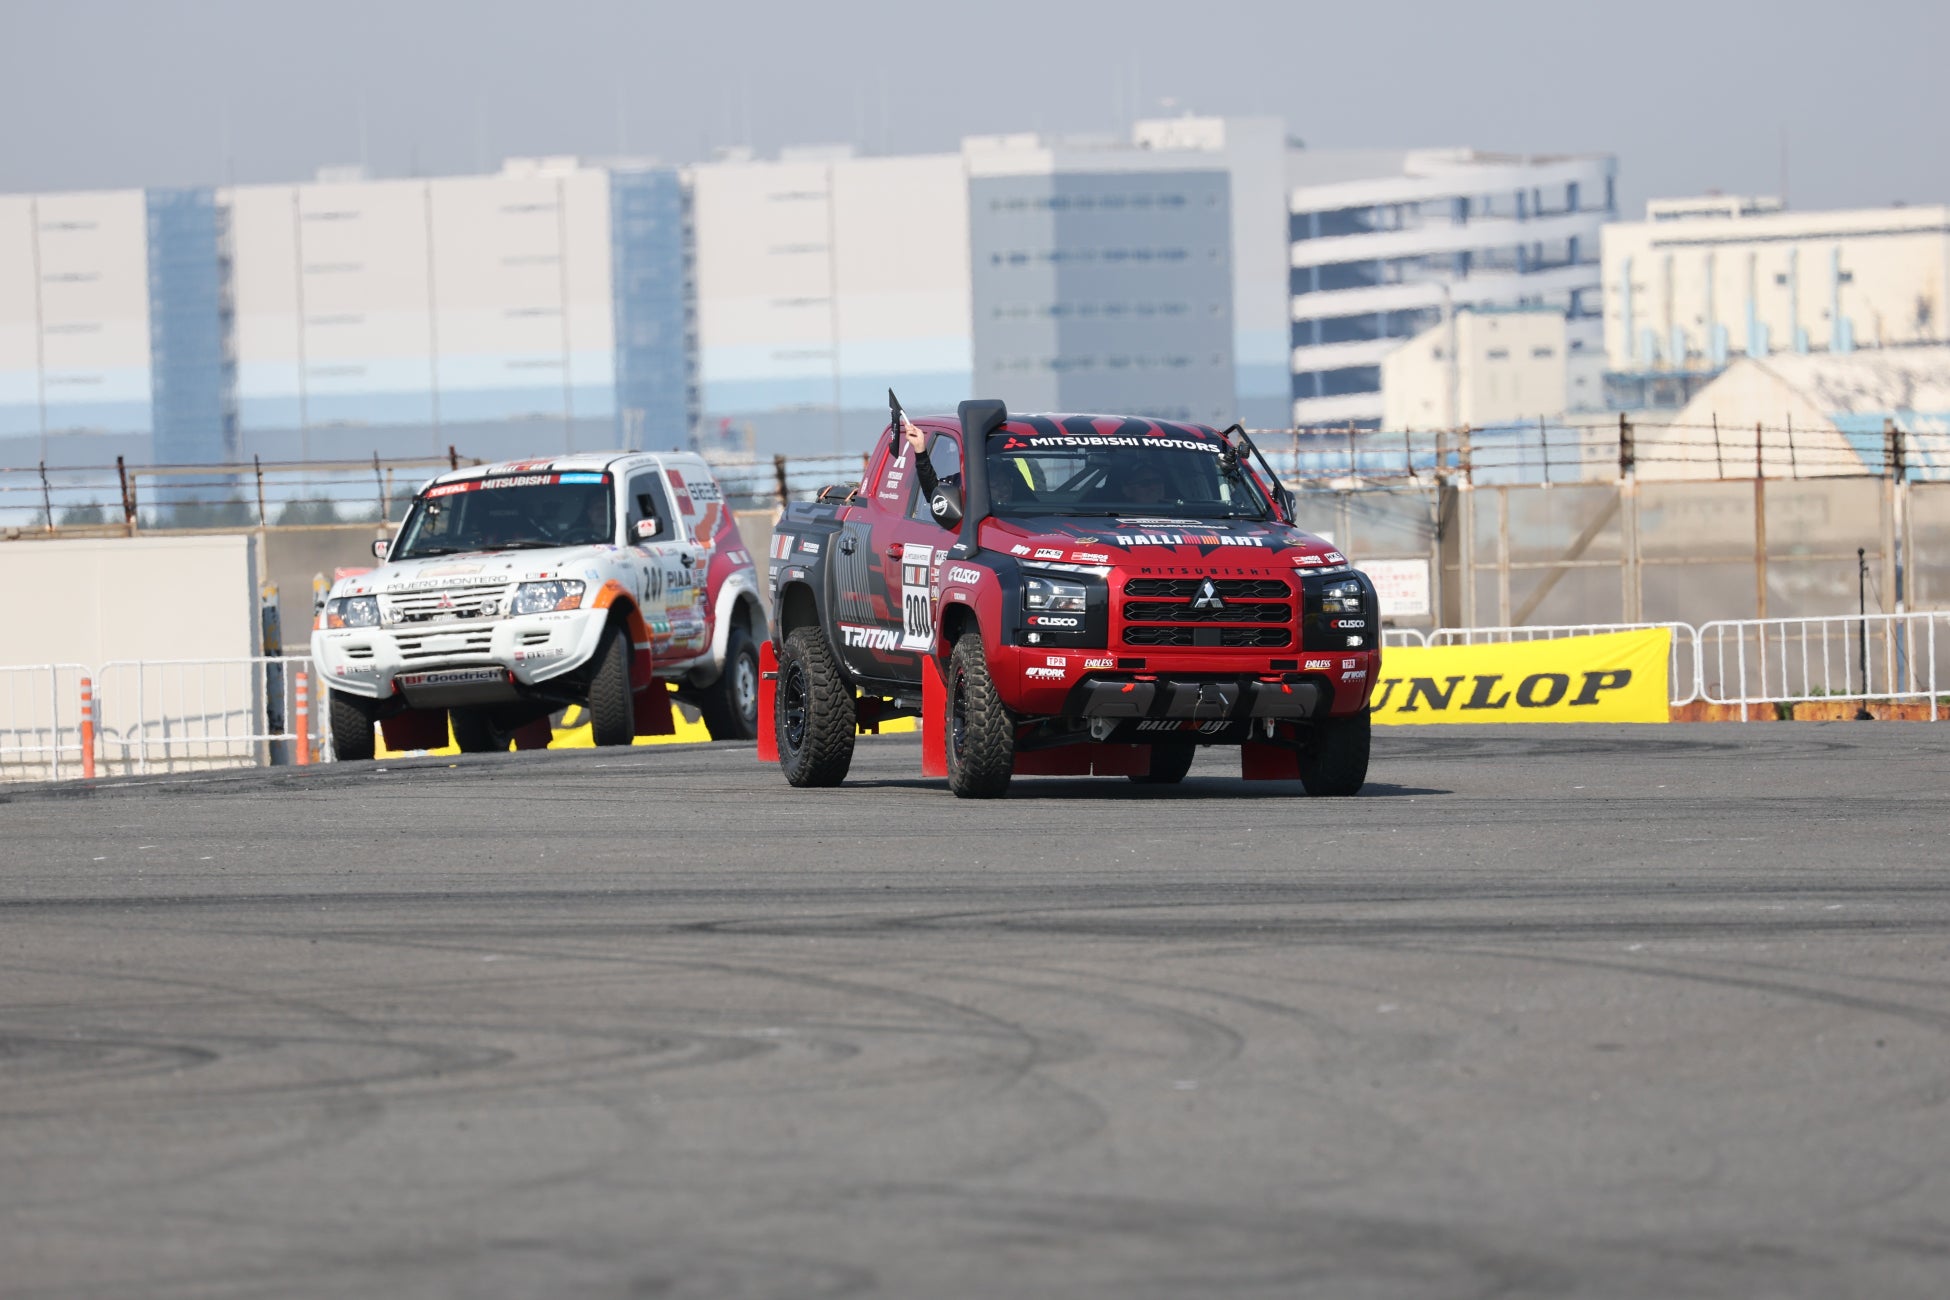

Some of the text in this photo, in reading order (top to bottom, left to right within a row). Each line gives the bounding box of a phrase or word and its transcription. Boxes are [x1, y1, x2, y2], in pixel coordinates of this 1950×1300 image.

[1030, 436, 1221, 453] MITSUBISHI MOTORS
[480, 475, 552, 490] MITSUBISHI
[431, 483, 468, 495] TOTAL
[1116, 535, 1264, 547] RALLI ART
[1037, 549, 1062, 557] HKS
[1326, 552, 1340, 560] HKS
[953, 567, 981, 585] CUSCO
[1141, 567, 1271, 576] MITSUBISHI
[386, 578, 439, 591] PAJERO
[442, 575, 508, 586] MONTERO
[643, 566, 663, 602] 201
[667, 569, 692, 590] PIAA
[906, 593, 931, 639] 200
[1037, 616, 1078, 627] CUSCO
[1338, 619, 1366, 628] CUSCO
[840, 625, 900, 651] TRITON
[1049, 657, 1066, 667] TPR
[1084, 659, 1114, 668] ENDLESS
[1304, 660, 1332, 669] ENDLESS
[405, 669, 500, 684] BFGoodrich
[1038, 667, 1066, 677] WORK
[1371, 669, 1632, 712] UNLOP
[1136, 720, 1233, 732] RALLI ART
